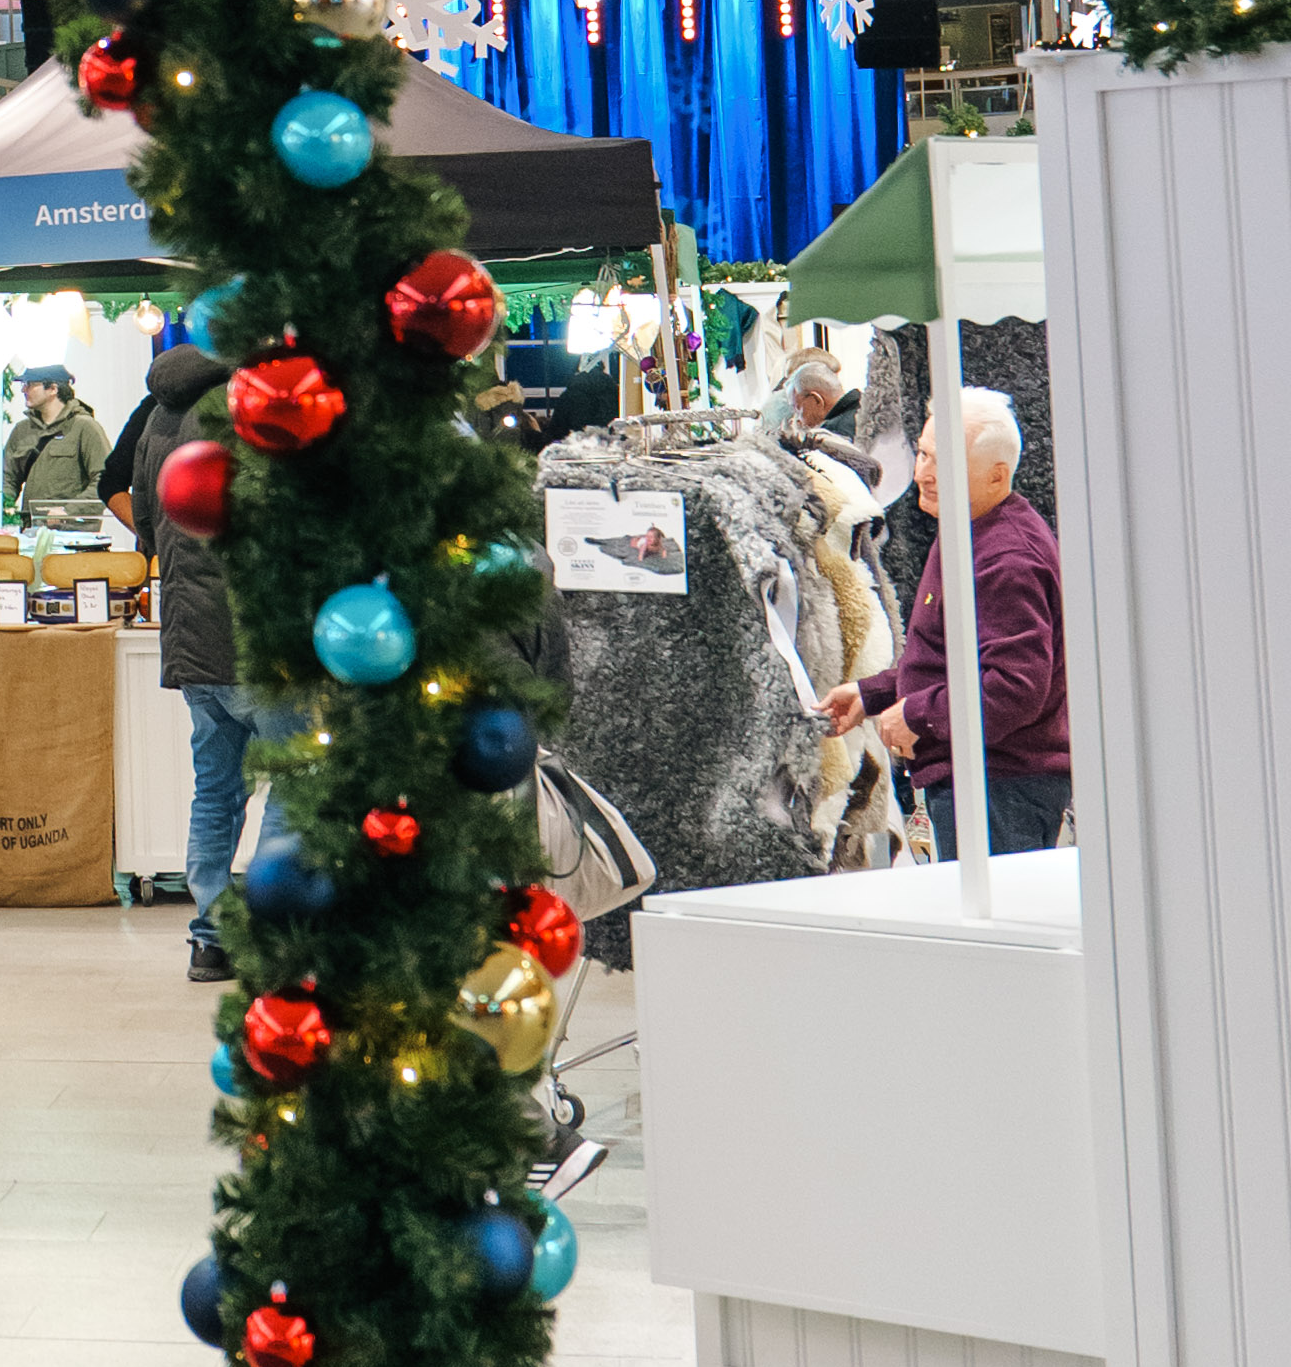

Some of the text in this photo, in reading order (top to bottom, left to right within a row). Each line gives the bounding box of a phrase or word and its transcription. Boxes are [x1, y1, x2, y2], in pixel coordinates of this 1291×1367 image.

[17, 813, 48, 831] ONLY
[1, 836, 17, 850] OF
[19, 827, 69, 849] UGANDA
